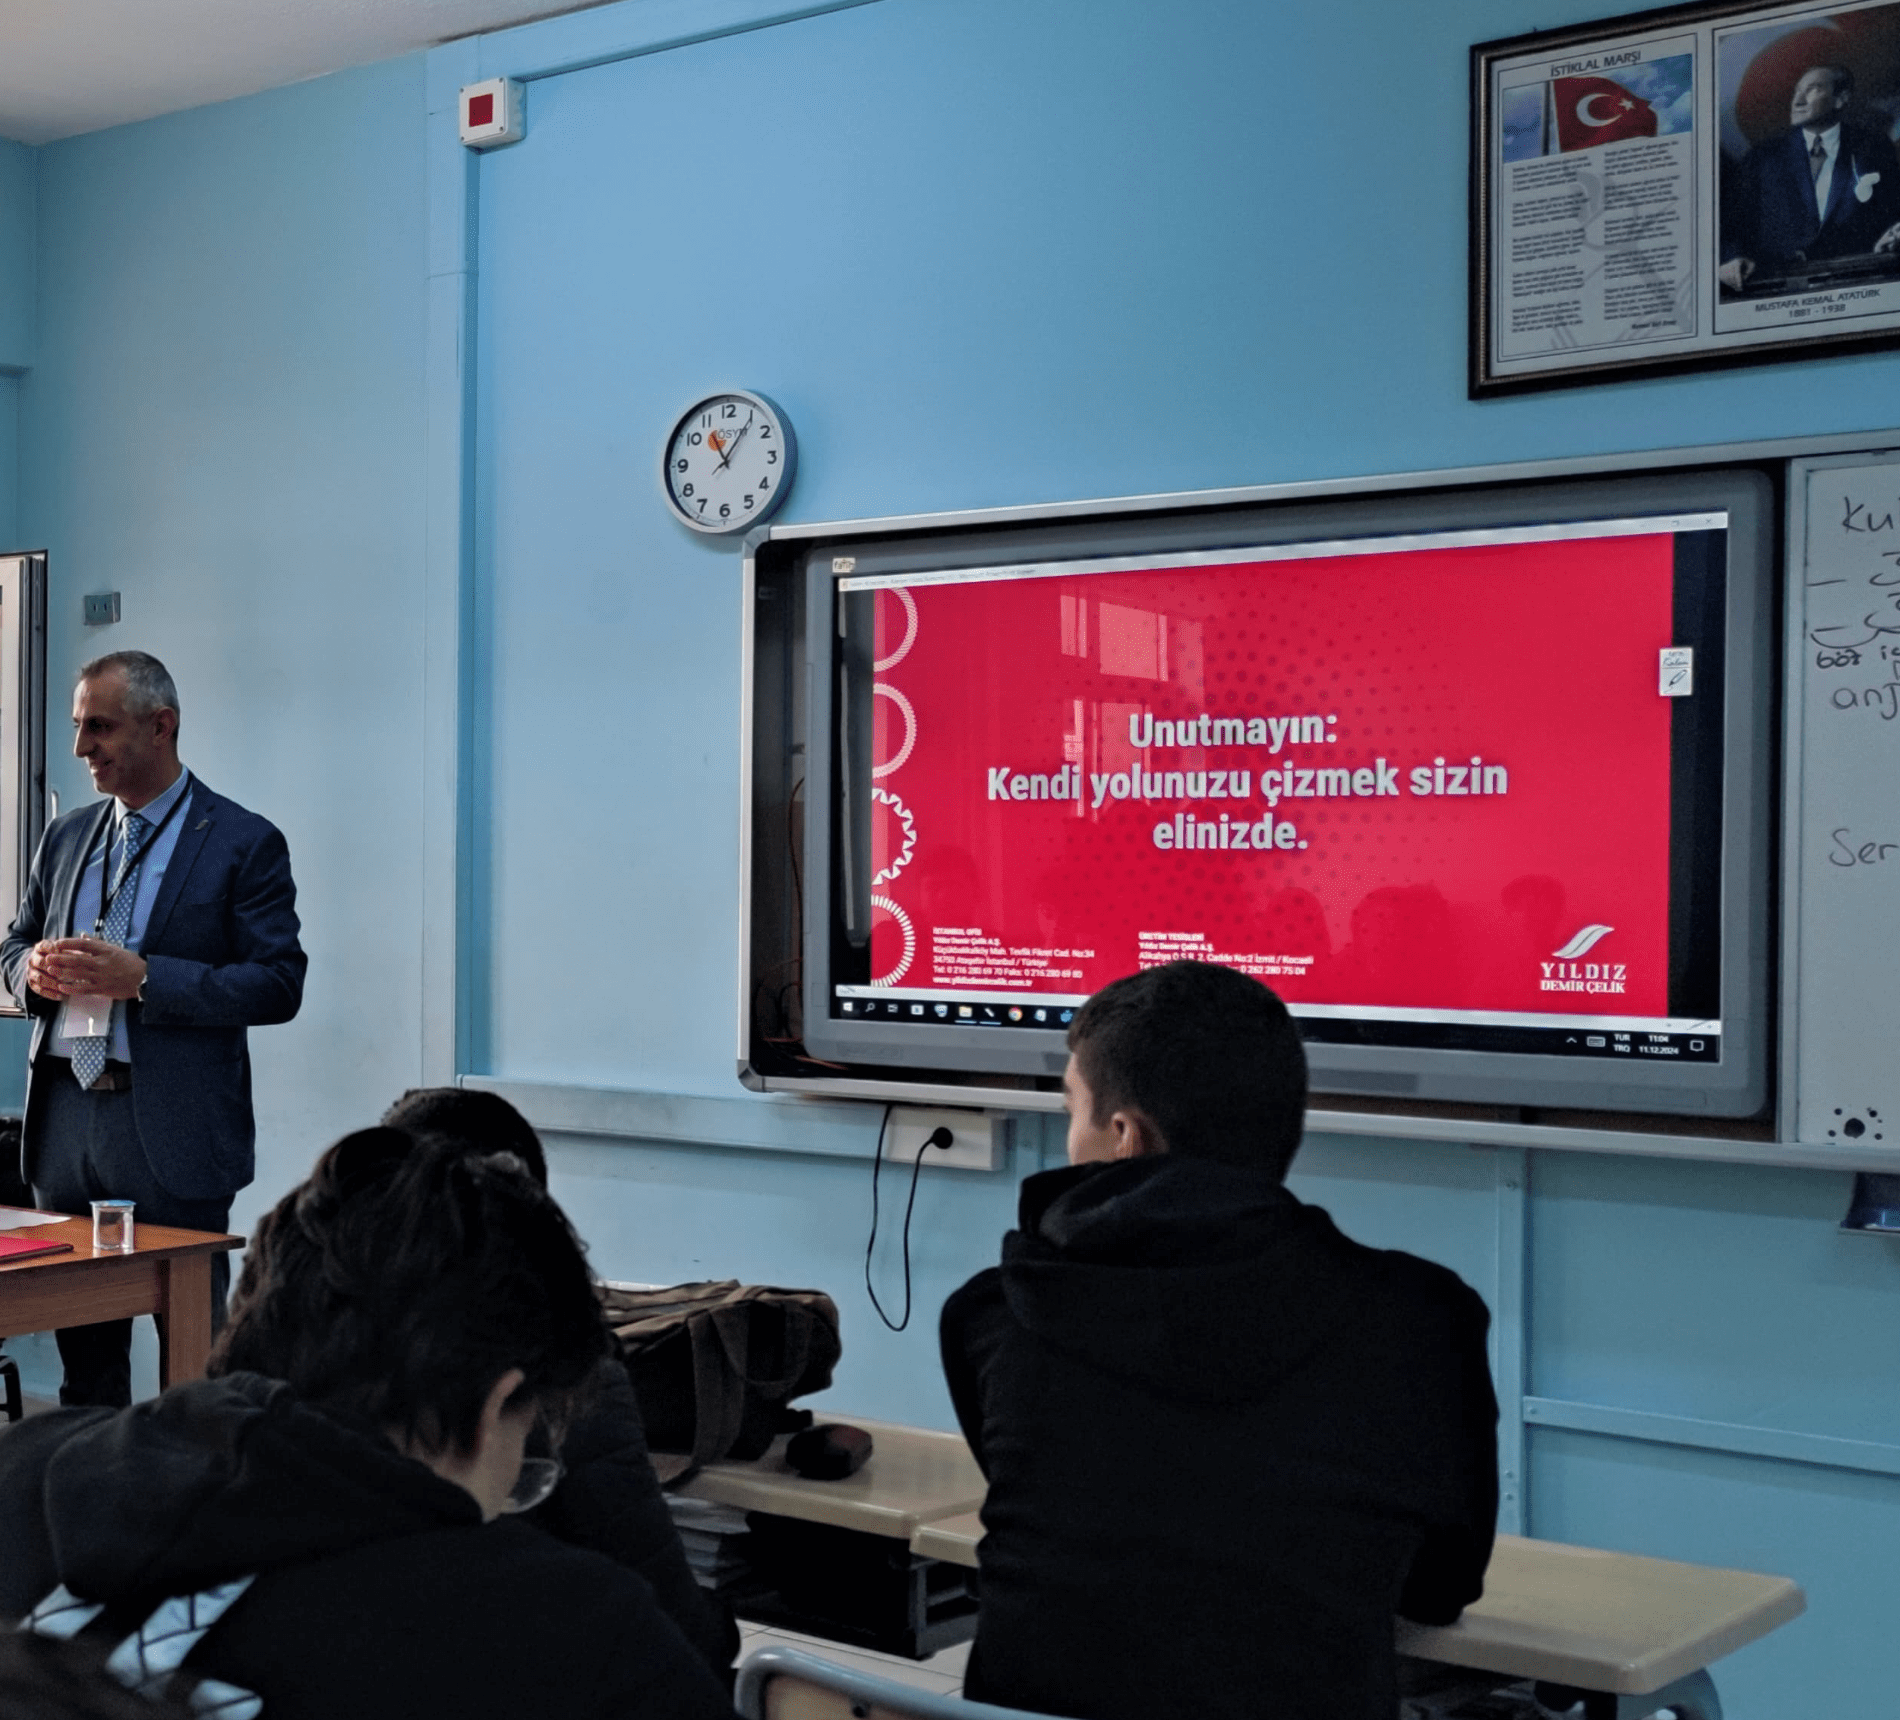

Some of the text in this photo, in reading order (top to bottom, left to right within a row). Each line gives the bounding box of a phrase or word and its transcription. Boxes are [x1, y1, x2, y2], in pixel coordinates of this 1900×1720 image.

[1550, 51, 1642, 77] İSTİKLAL MARŞI
[1755, 288, 1881, 312] MUSTAFA KEMAL ATATÜRK
[721, 404, 737, 419] 12
[702, 414, 711, 428] 11
[686, 432, 702, 446] 10
[760, 425, 771, 439] 2
[767, 450, 777, 465] 3
[677, 459, 689, 473] 9
[682, 483, 694, 497] 8
[758, 476, 769, 491] 4
[696, 498, 708, 513] 7
[743, 494, 754, 509] 5
[719, 503, 731, 518] 6
[1842, 496, 1900, 534] Ku
[1129, 713, 1337, 754] Unutmayın:
[988, 756, 1508, 809] Kendi yolunuzu çizmek sizin
[1153, 811, 1308, 850] elinizde.
[1540, 962, 1627, 980] YILDIZ
[1540, 979, 1625, 994] DEMİR ÇELİK
